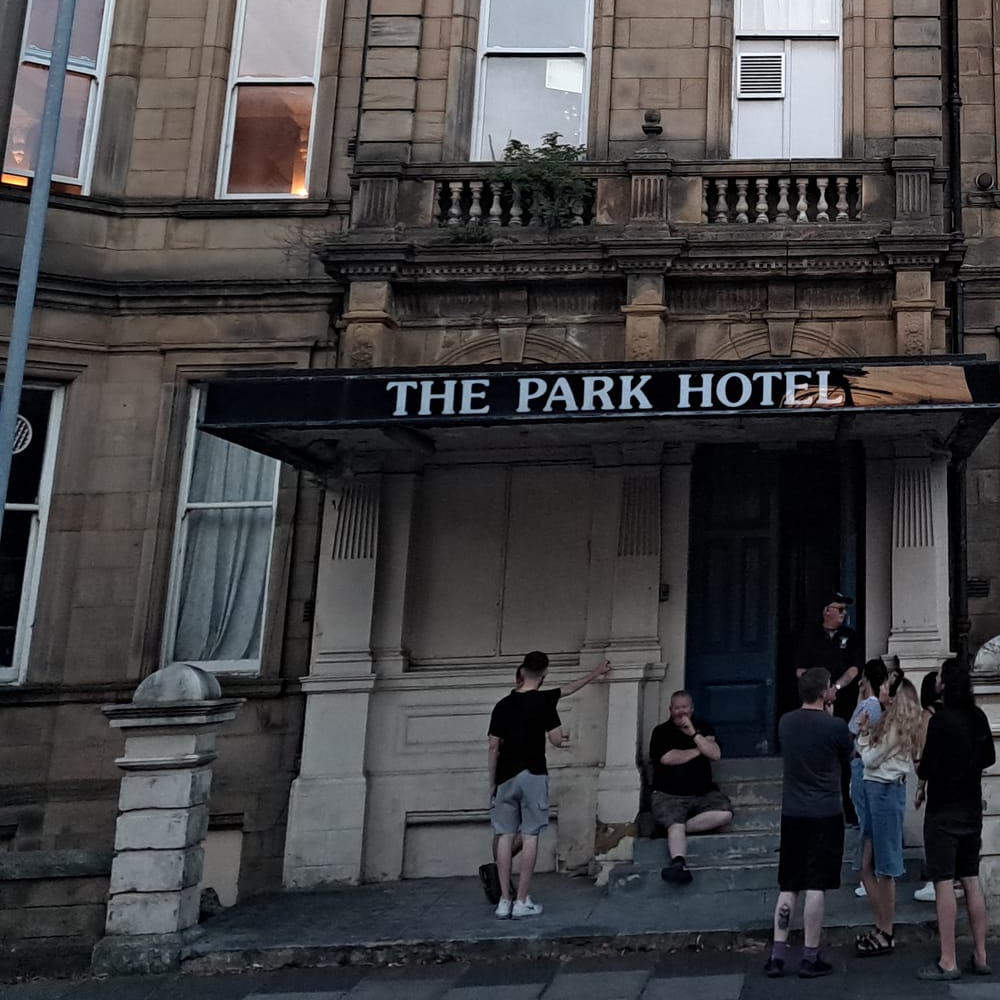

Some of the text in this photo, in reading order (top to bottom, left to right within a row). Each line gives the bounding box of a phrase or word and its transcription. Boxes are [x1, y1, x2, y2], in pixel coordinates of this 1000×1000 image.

[386, 370, 844, 416] THE PARK HOTEL
